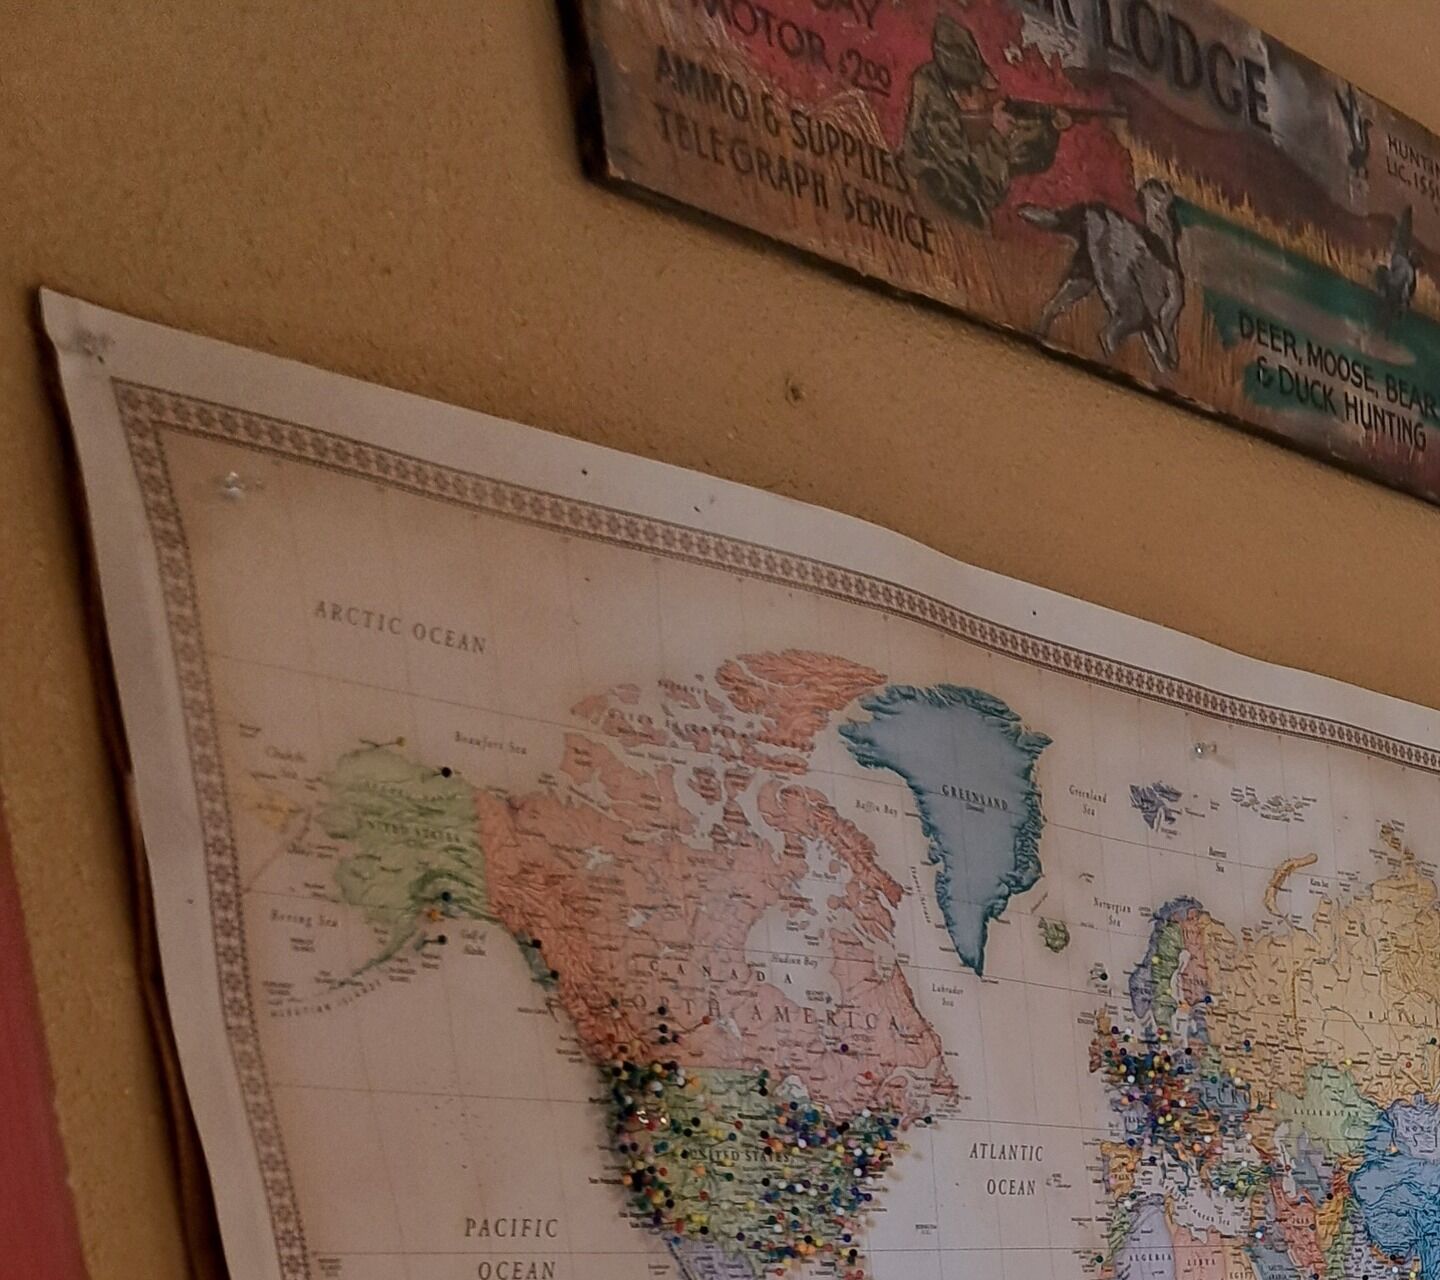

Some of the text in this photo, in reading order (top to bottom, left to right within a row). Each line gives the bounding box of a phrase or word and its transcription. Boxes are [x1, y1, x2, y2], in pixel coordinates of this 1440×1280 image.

[1102, 0, 1273, 134] LODGE
[655, 45, 749, 121] AMMO
[791, 109, 911, 194] SUPPLIES
[652, 101, 935, 255] TELEGRAPH SERVICE
[1306, 338, 1380, 399] MOOSE,
[1385, 373, 1440, 422] BEAR
[1278, 365, 1337, 415] DUCK
[1344, 391, 1428, 452] HUNTING
[314, 601, 487, 655] ARCTIC OCEAN
[942, 784, 1010, 812] GREENLAND
[751, 1004, 901, 1032] AMERICA
[969, 1142, 1044, 1163] ATLANTIC
[986, 1178, 1036, 1196] OCEAN
[465, 1217, 560, 1239] PACIFIC
